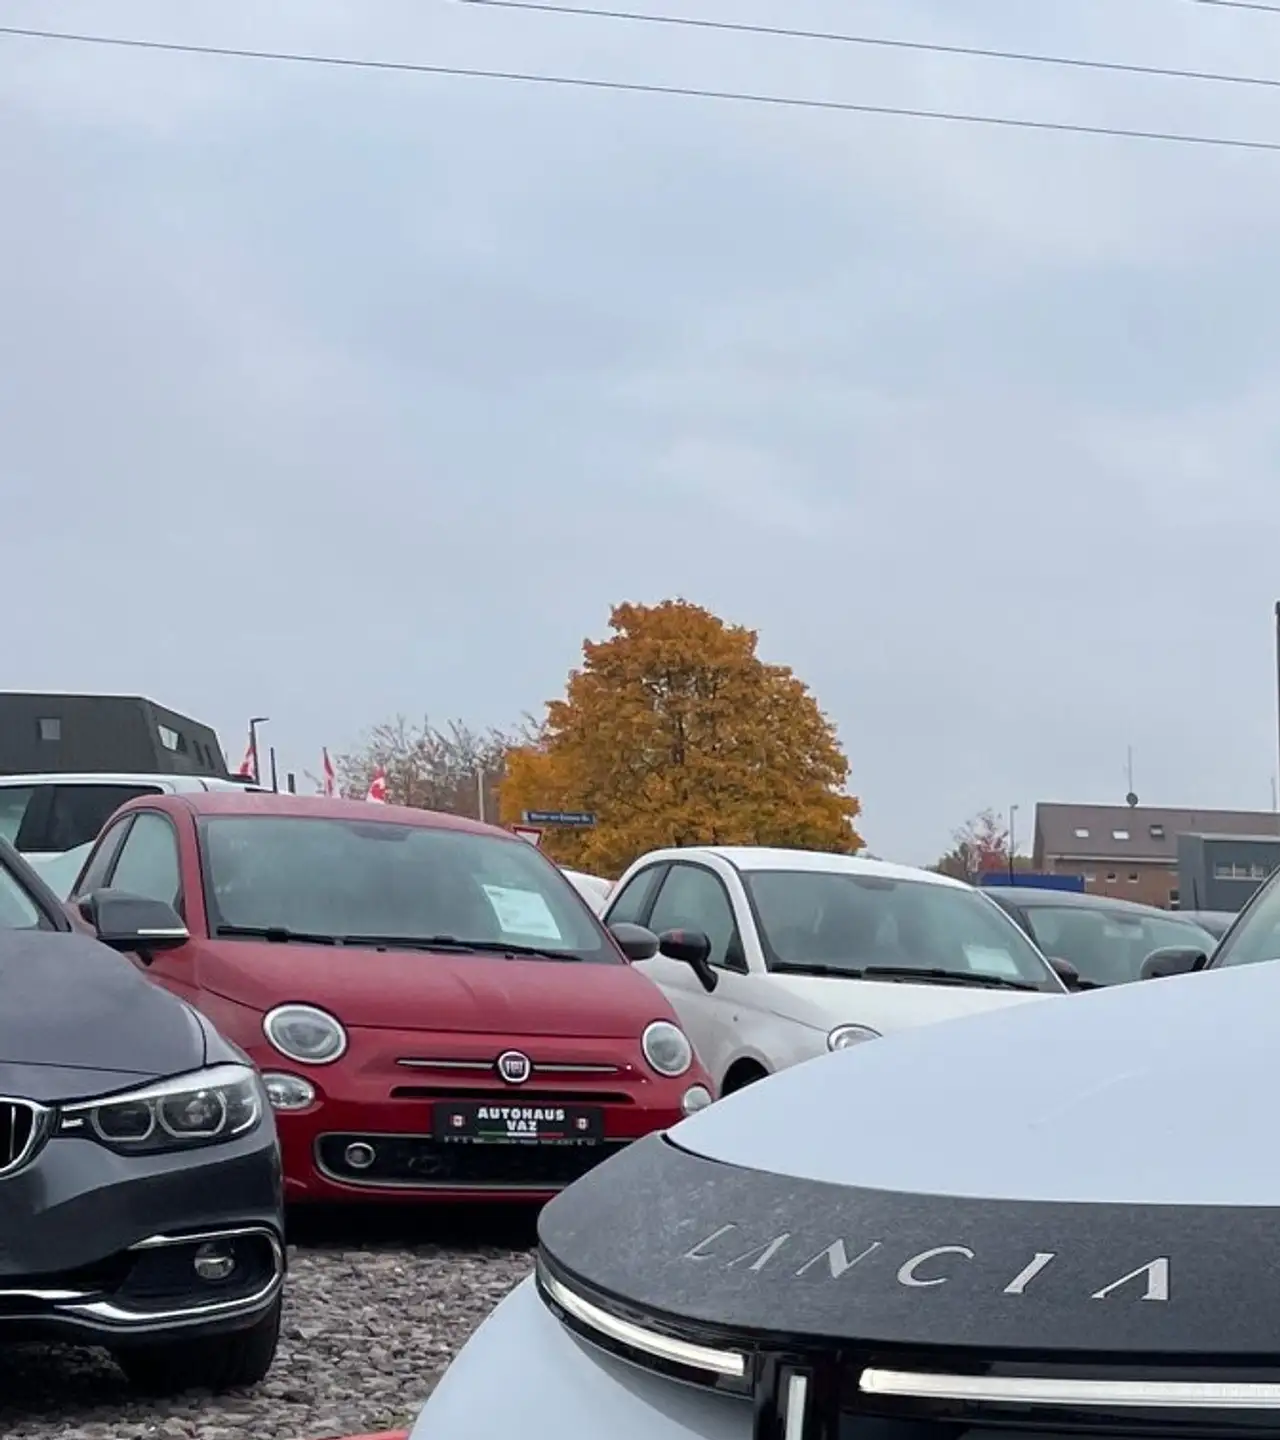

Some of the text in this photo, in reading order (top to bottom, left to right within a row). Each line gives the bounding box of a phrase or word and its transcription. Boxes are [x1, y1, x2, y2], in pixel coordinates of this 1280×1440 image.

[477, 1107, 565, 1121] AUTOHAUS
[506, 1120, 538, 1132] VAZ
[682, 1224, 1171, 1301] LANCIA
